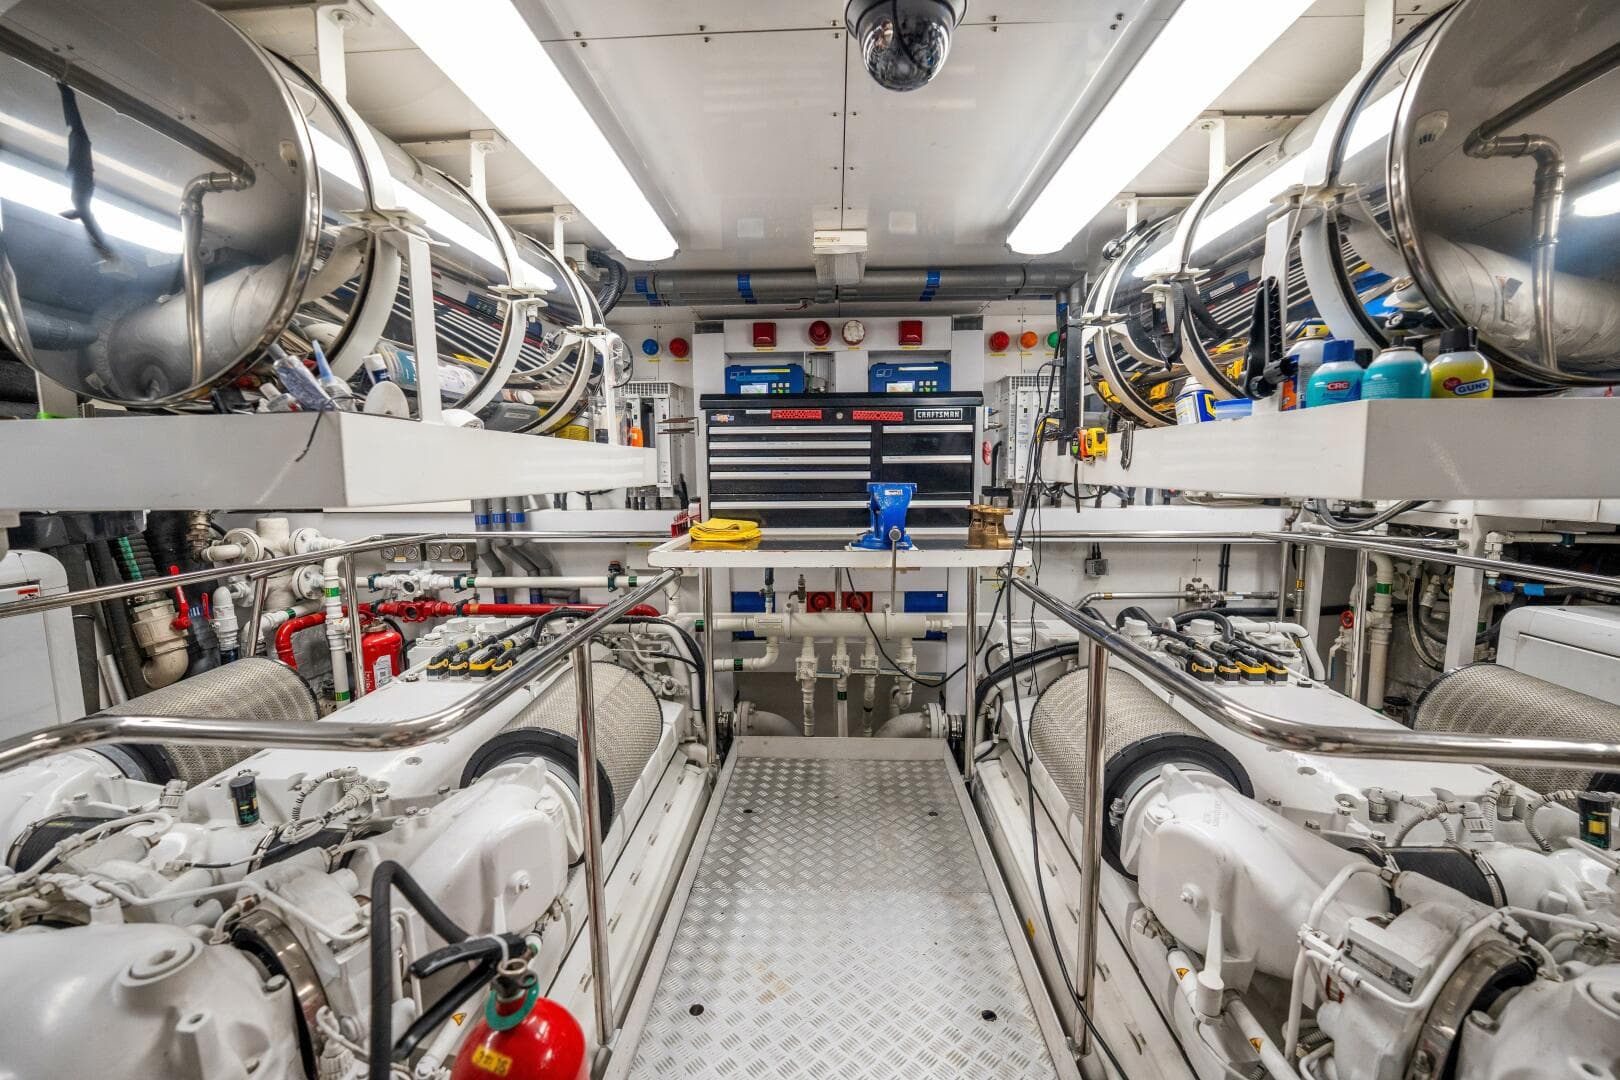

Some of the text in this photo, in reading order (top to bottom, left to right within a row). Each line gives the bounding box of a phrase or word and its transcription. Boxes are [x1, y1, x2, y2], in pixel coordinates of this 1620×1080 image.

[1327, 382, 1350, 390] CRC
[1457, 382, 1488, 393] GUNK
[917, 410, 960, 419] CRAFTSMAN
